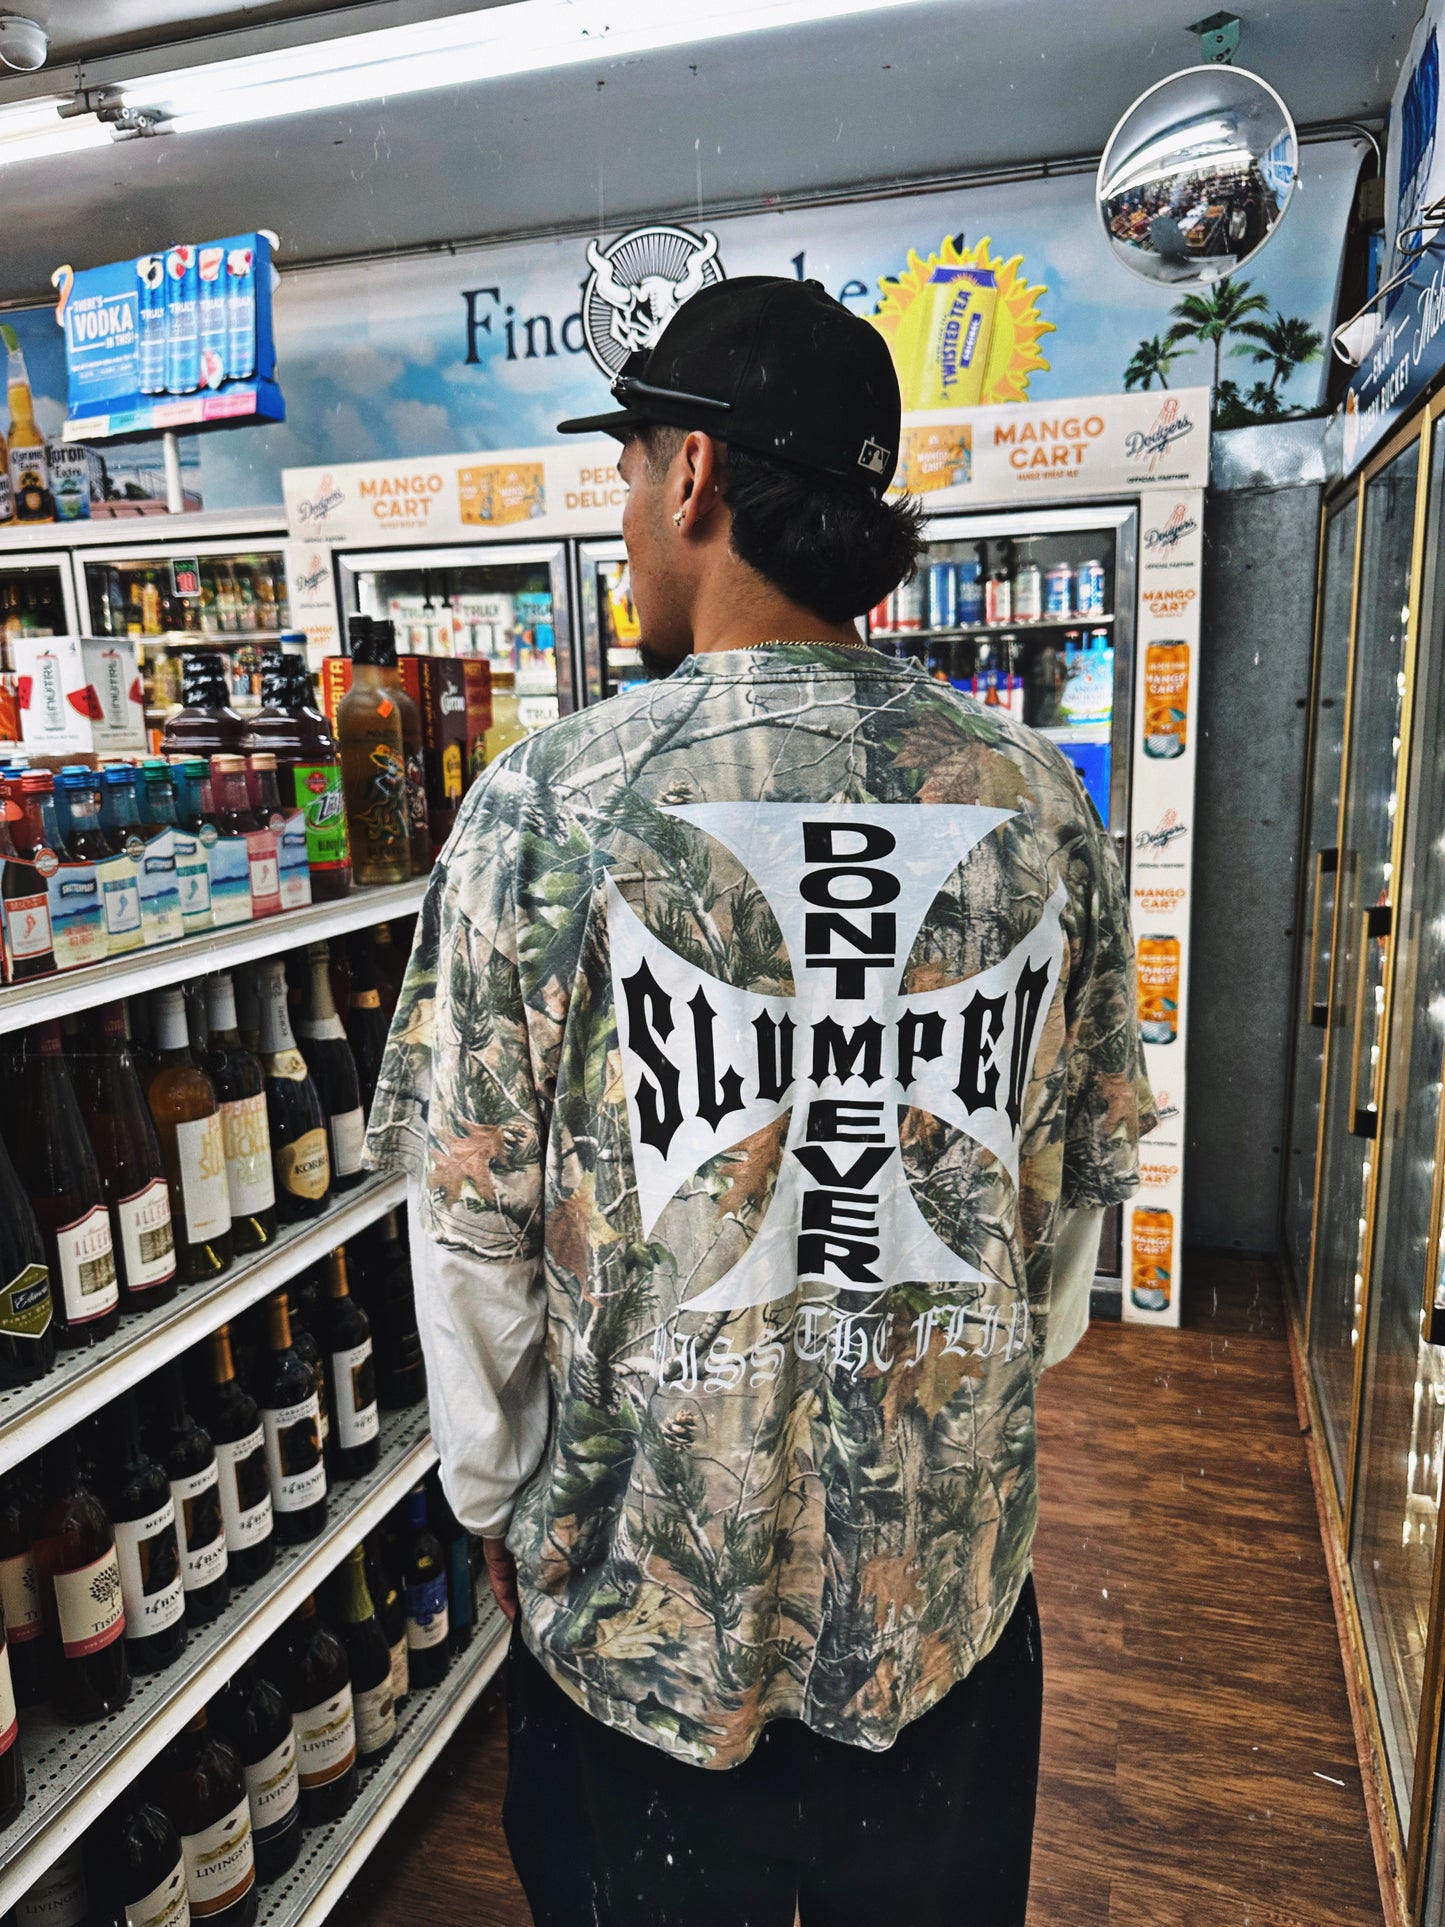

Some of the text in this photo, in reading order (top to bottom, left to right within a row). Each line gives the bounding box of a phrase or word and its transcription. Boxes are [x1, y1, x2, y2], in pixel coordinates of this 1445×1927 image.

[73, 295, 103, 312] THERE'S
[140, 307, 164, 320] TRULY
[168, 300, 196, 313] TRULY
[74, 303, 134, 341] VODKA
[942, 290, 972, 387] TWISTED TEA
[1373, 326, 1396, 384] ENJOY
[993, 416, 1105, 446] MANGO
[1124, 414, 1195, 457] Dodgers
[1009, 443, 1089, 469] CART
[359, 474, 443, 497] MANGO
[1126, 475, 1157, 485] OFFICIAL
[373, 497, 432, 519] CART
[1144, 517, 1198, 549] Dodgers
[1143, 589, 1196, 601] MANGO
[463, 604, 500, 617] TRULY
[1149, 601, 1188, 613] CART
[1135, 824, 1188, 850] Dodgers
[1134, 888, 1185, 898] MANGO
[1141, 899, 1177, 909] CART
[800, 822, 901, 999] DONT
[621, 955, 1052, 1161] SLUMPED
[1141, 1164, 1178, 1175] ANGO
[1145, 1175, 1170, 1184] ART
[791, 1099, 897, 1284] EVER
[145, 1598, 160, 1614] 14
